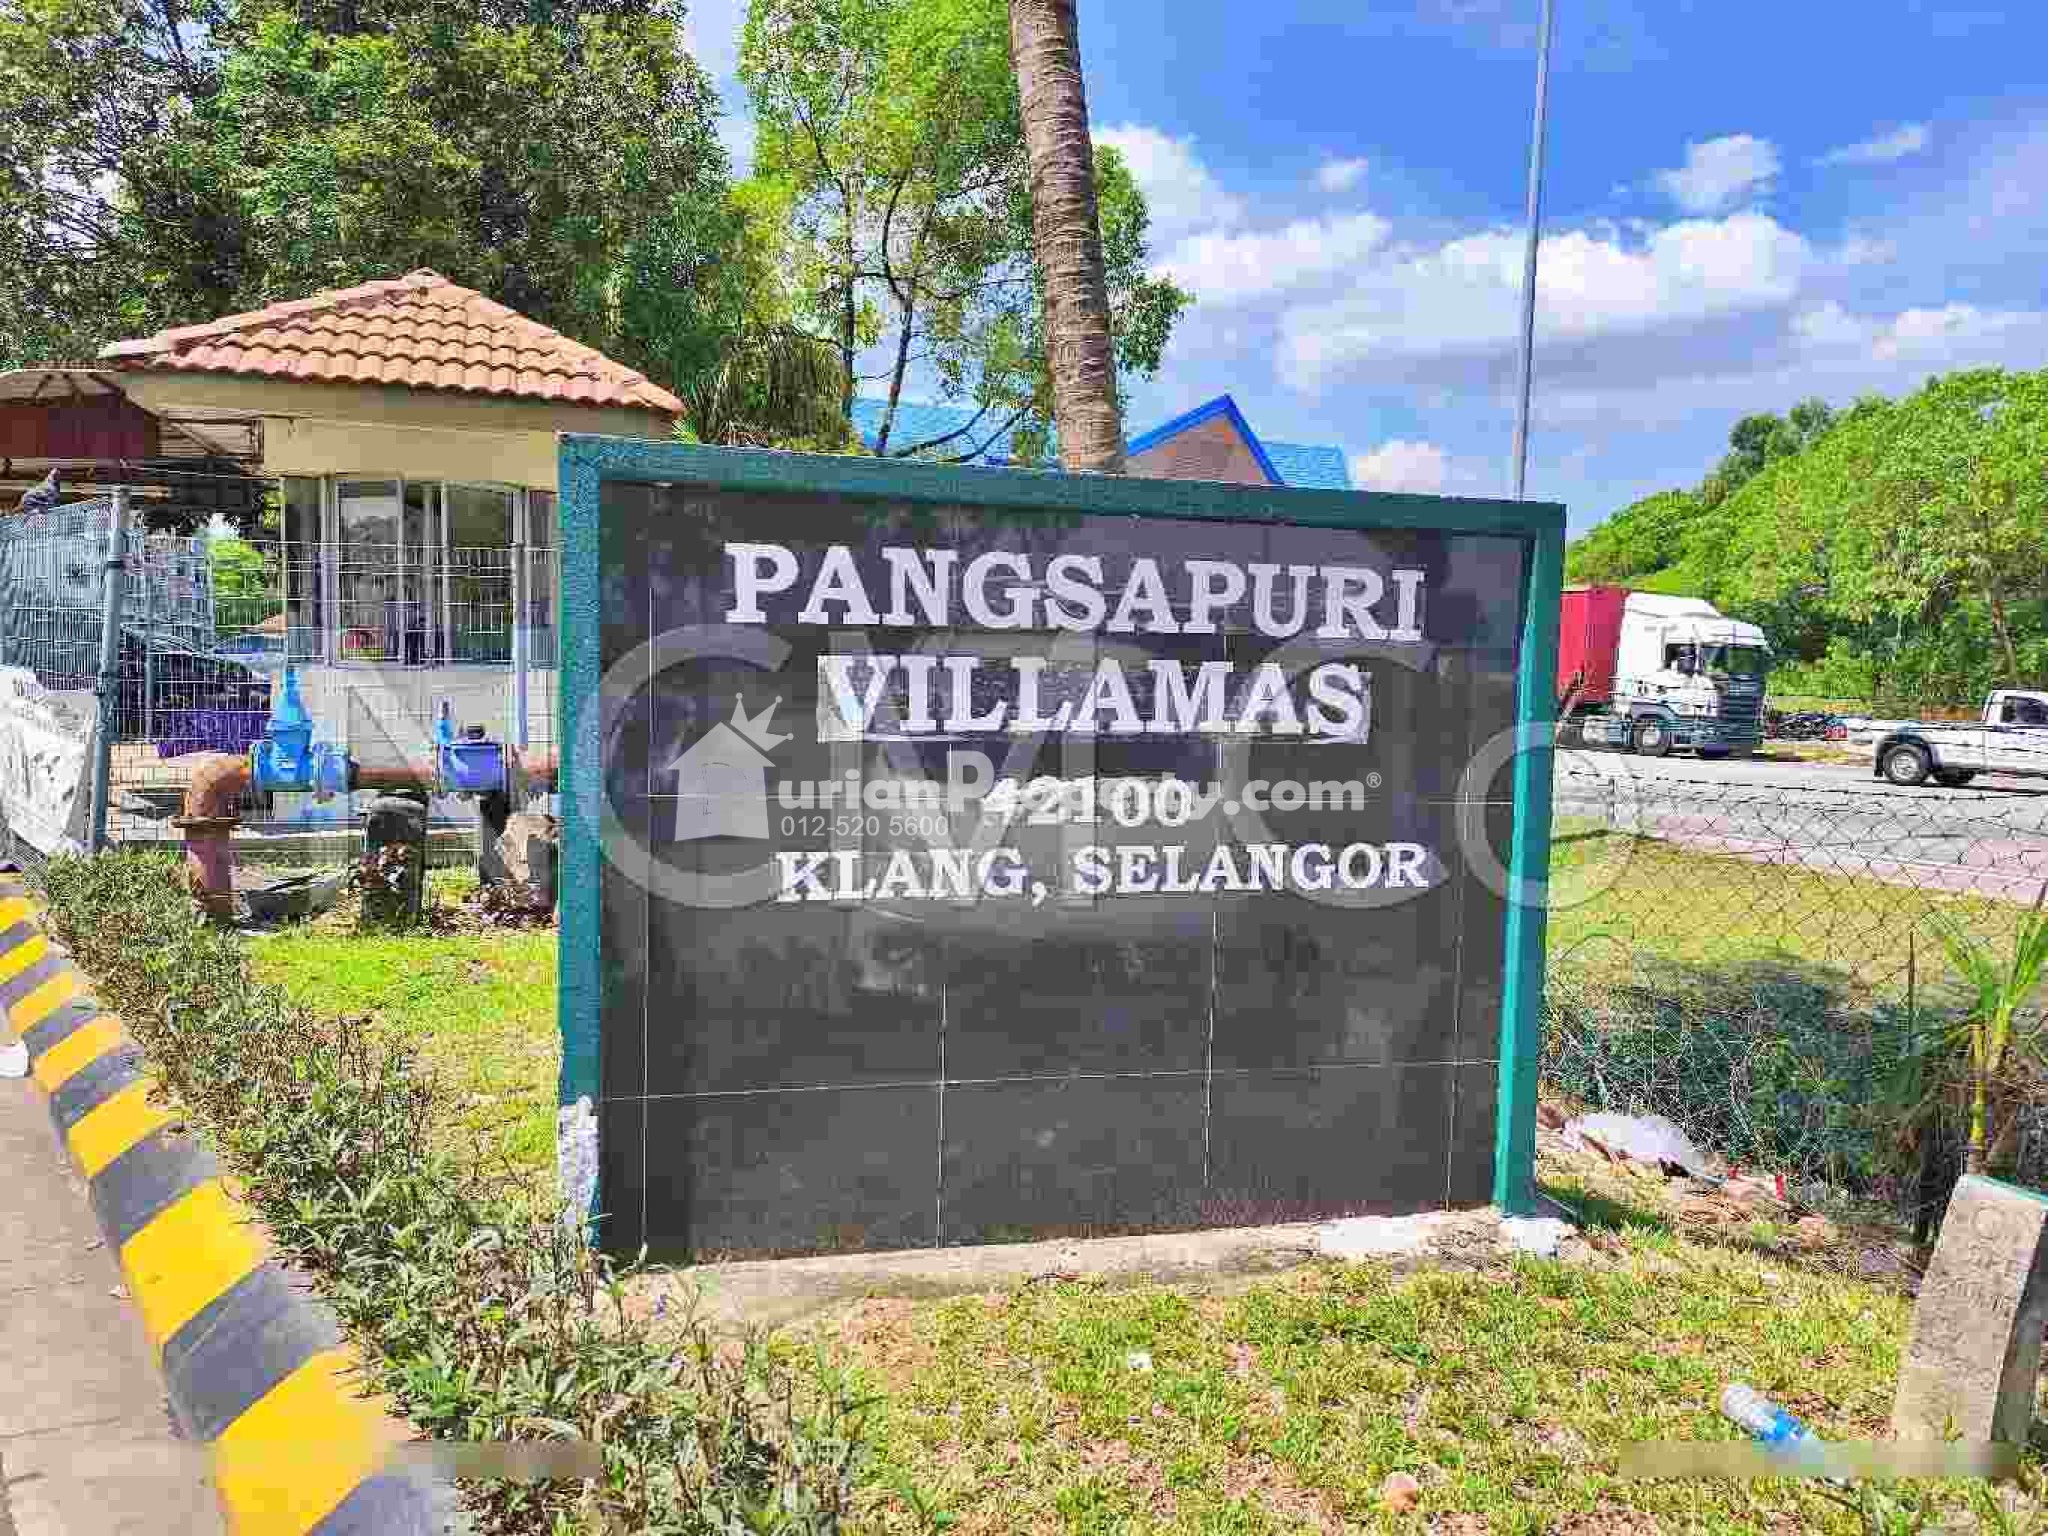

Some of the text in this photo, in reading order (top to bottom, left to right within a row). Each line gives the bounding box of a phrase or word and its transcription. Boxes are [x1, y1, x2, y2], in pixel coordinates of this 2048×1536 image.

[724, 541, 1425, 642] PANGSAPURI
[820, 656, 1366, 742] VILLAMAS
[981, 774, 1196, 828] 42100
[773, 840, 1433, 905] KLANG, SELANGOR
